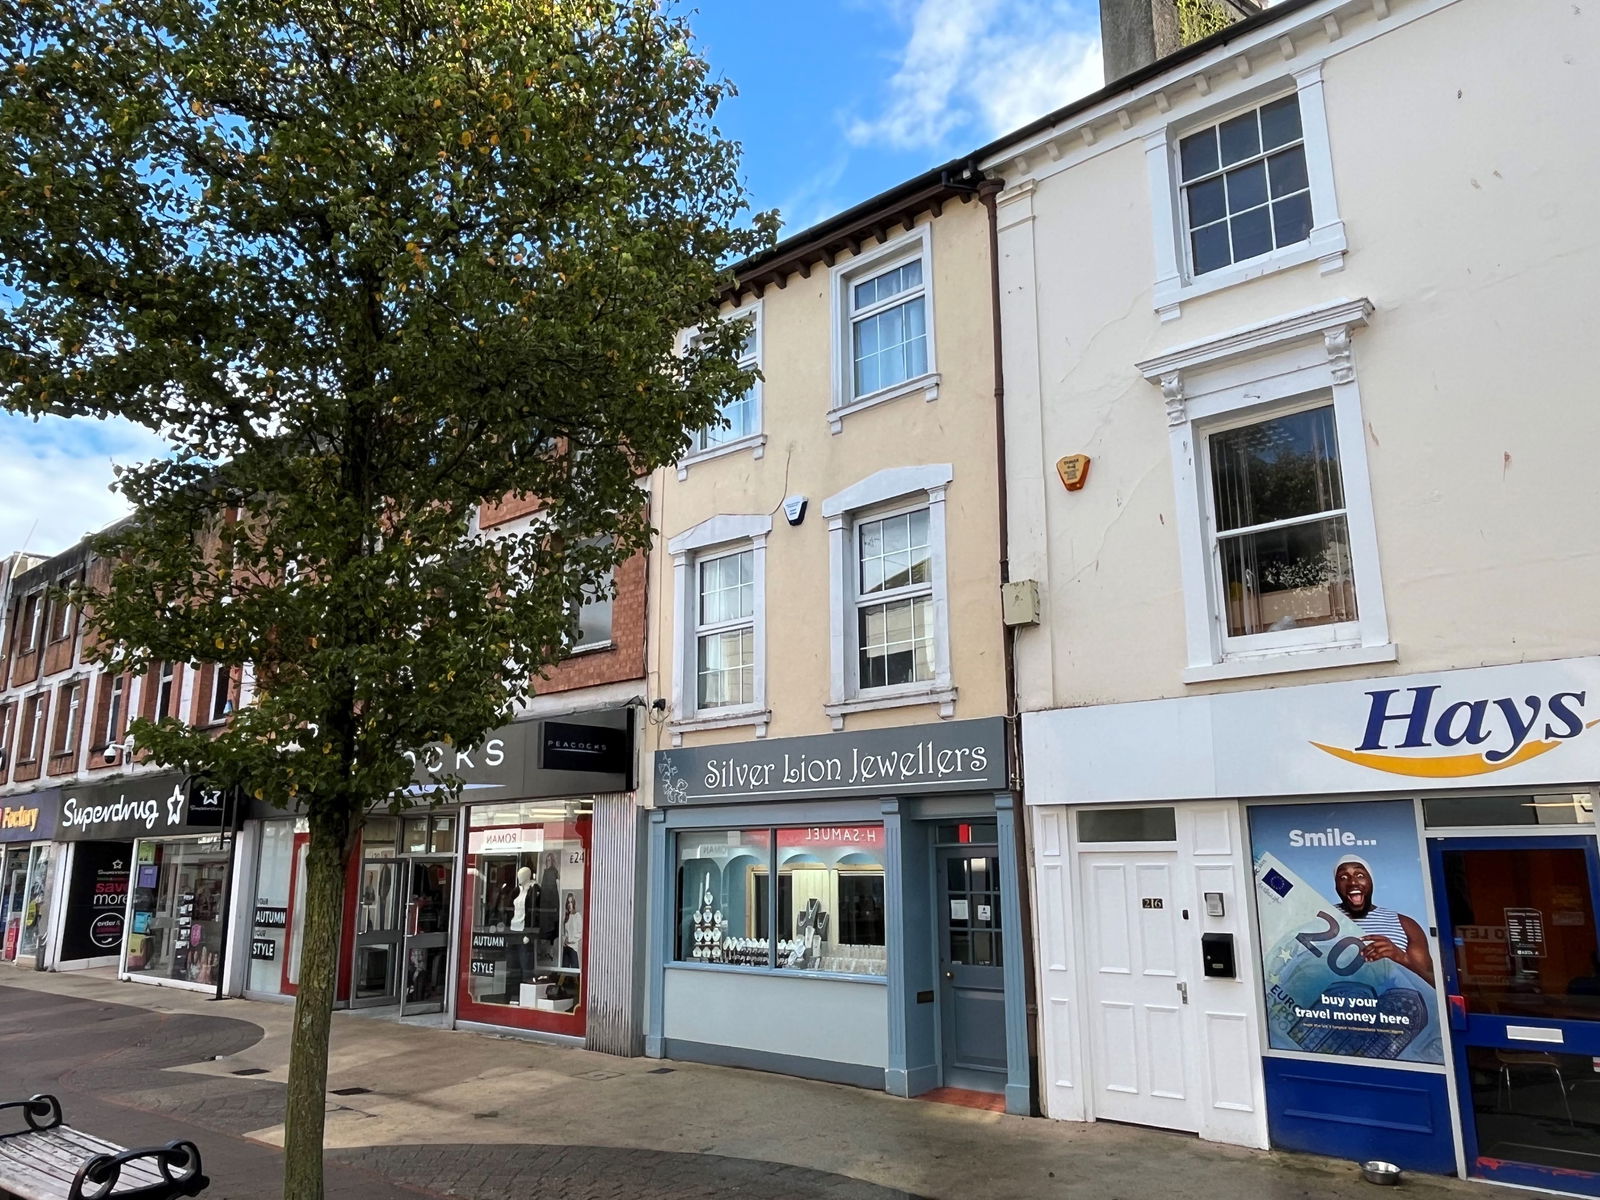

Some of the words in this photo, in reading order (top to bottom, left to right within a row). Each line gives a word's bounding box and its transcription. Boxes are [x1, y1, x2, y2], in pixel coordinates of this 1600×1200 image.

[1354, 684, 1587, 762] Hays
[547, 740, 607, 751] PEACOCKS
[704, 757, 775, 790] Silver
[782, 754, 842, 784] Lion
[848, 740, 988, 784] Jewellers
[2, 805, 39, 832] Factory
[62, 794, 160, 832] Superdrug
[1288, 828, 1377, 847] Smile...
[93, 894, 128, 905] more
[1143, 899, 1162, 908] 26
[255, 910, 286, 924] AUTUMN
[473, 935, 505, 947] AUTUMN
[1295, 910, 1367, 977] 20
[252, 942, 274, 957] STYLE
[471, 961, 494, 974] STYLE
[1321, 993, 1346, 1008] buy
[1349, 998, 1378, 1008] your
[1294, 1007, 1331, 1020] travel
[1333, 1010, 1377, 1024] money
[1379, 1012, 1410, 1025] here
